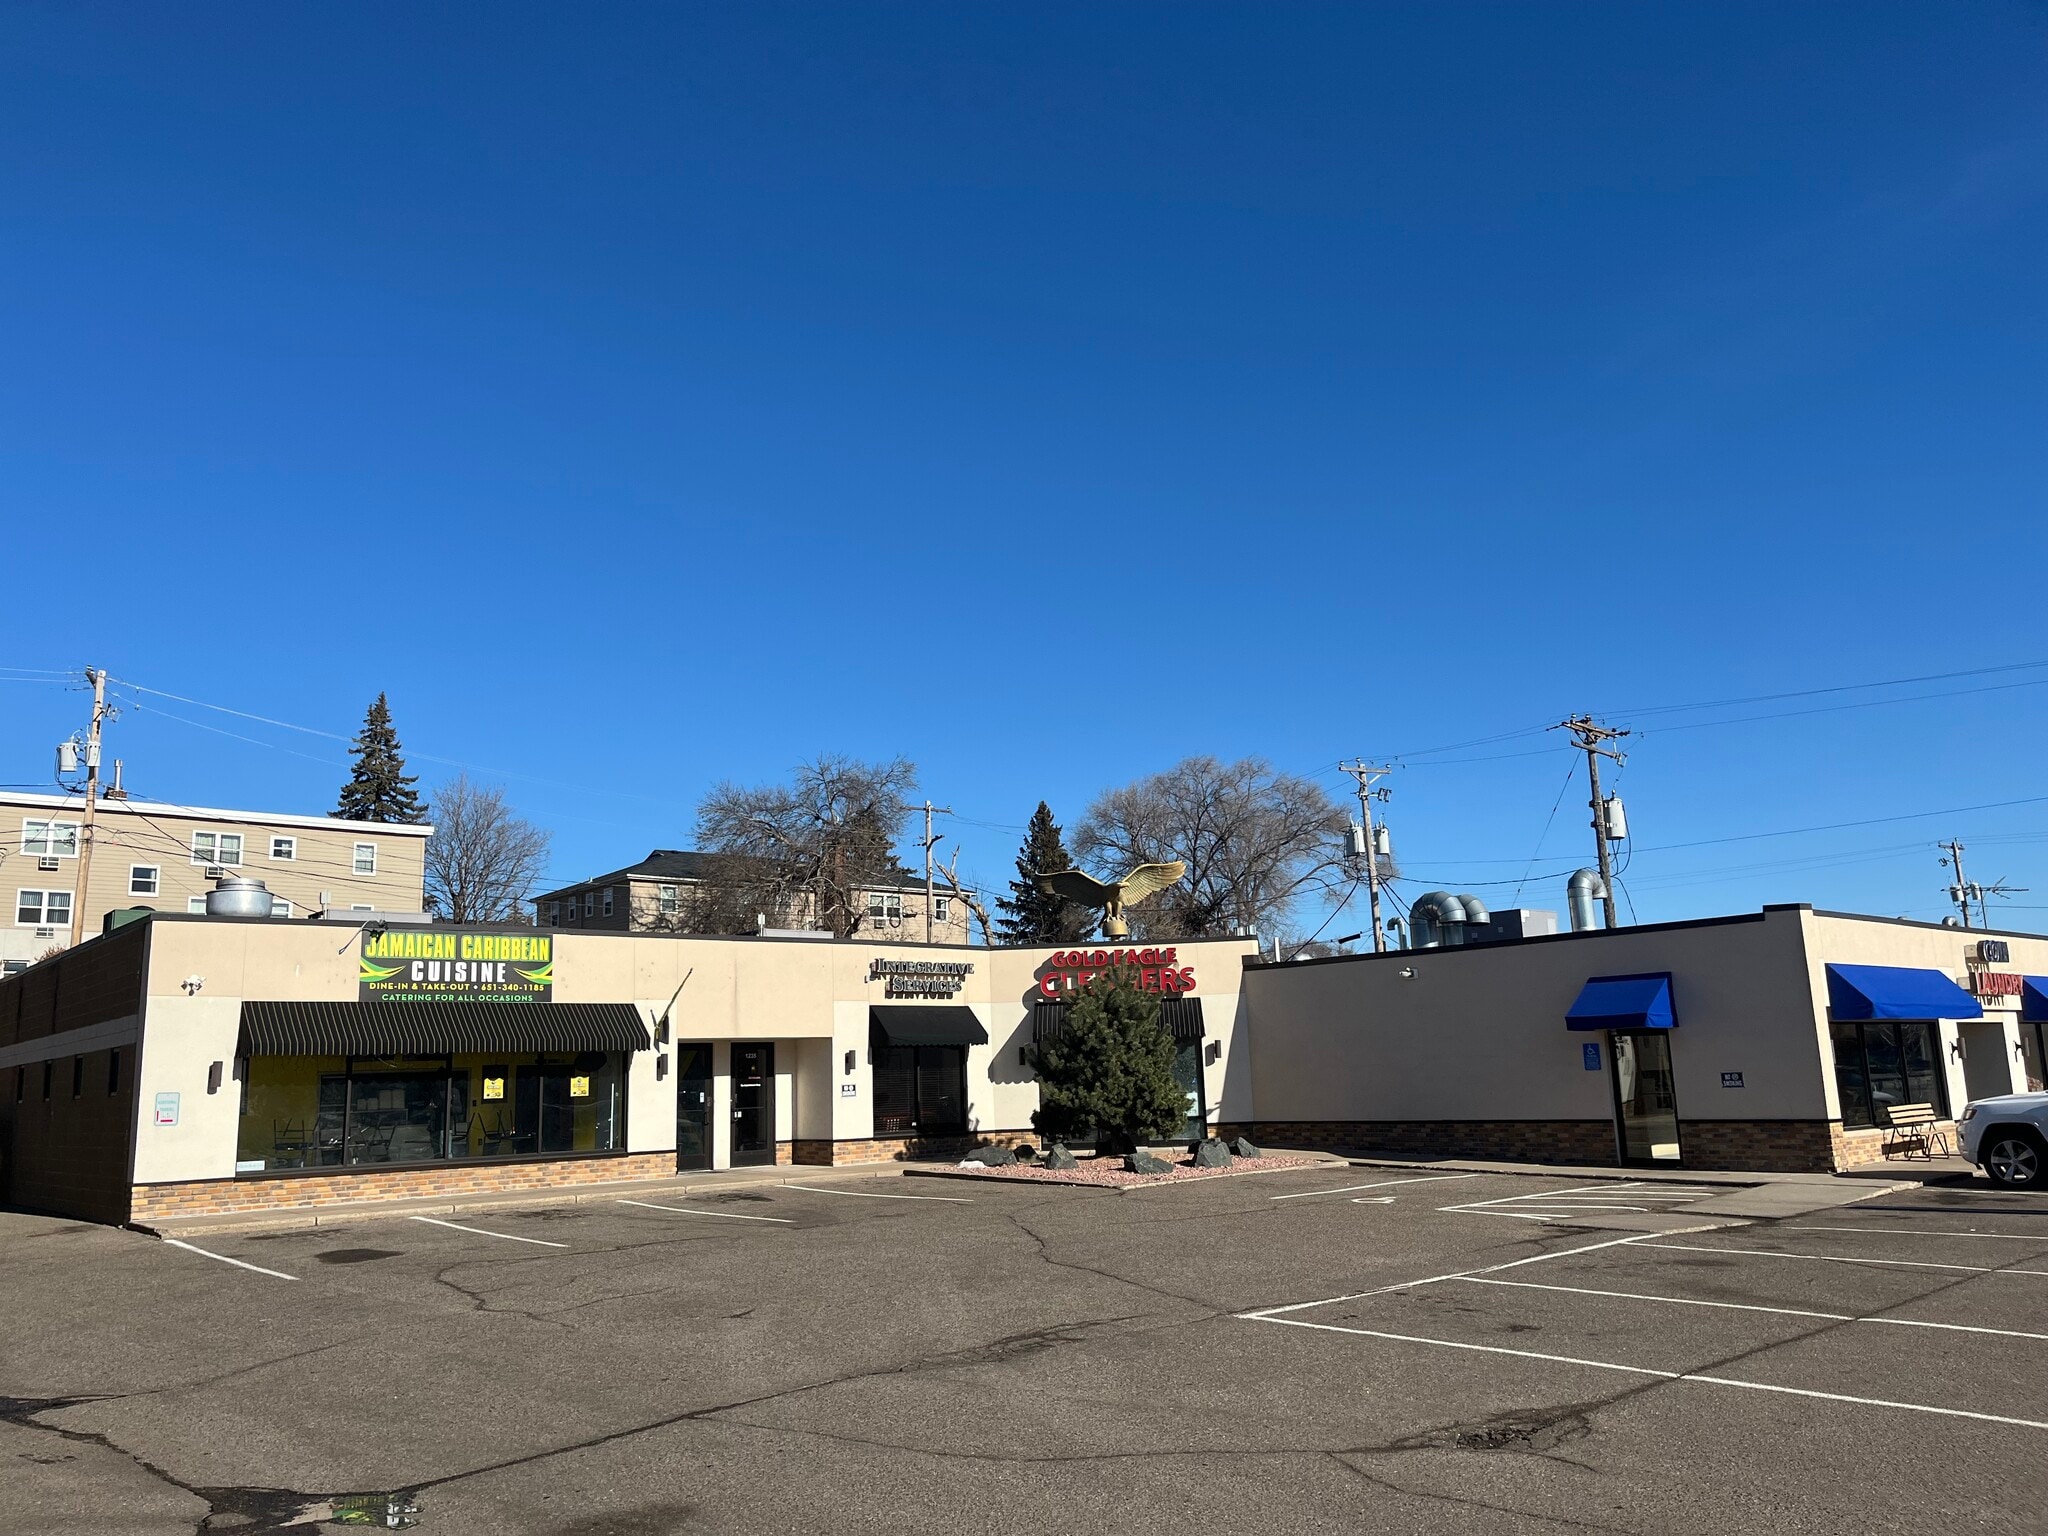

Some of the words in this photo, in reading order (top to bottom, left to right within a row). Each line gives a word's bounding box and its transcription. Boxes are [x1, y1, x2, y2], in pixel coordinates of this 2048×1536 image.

[365, 931, 457, 960] JAMAICAN
[461, 934, 550, 962] CARIBBEAN
[877, 958, 975, 975] INTEGRATIVE
[1051, 950, 1109, 968] GOLD
[1114, 947, 1178, 966] EAGLE
[411, 960, 506, 983] CUISINE
[369, 982, 409, 990] DINE-IN
[421, 983, 470, 991] TAKE-OUT
[893, 976, 962, 993] SERVICES
[1974, 972, 2024, 997] LAUNDRY
